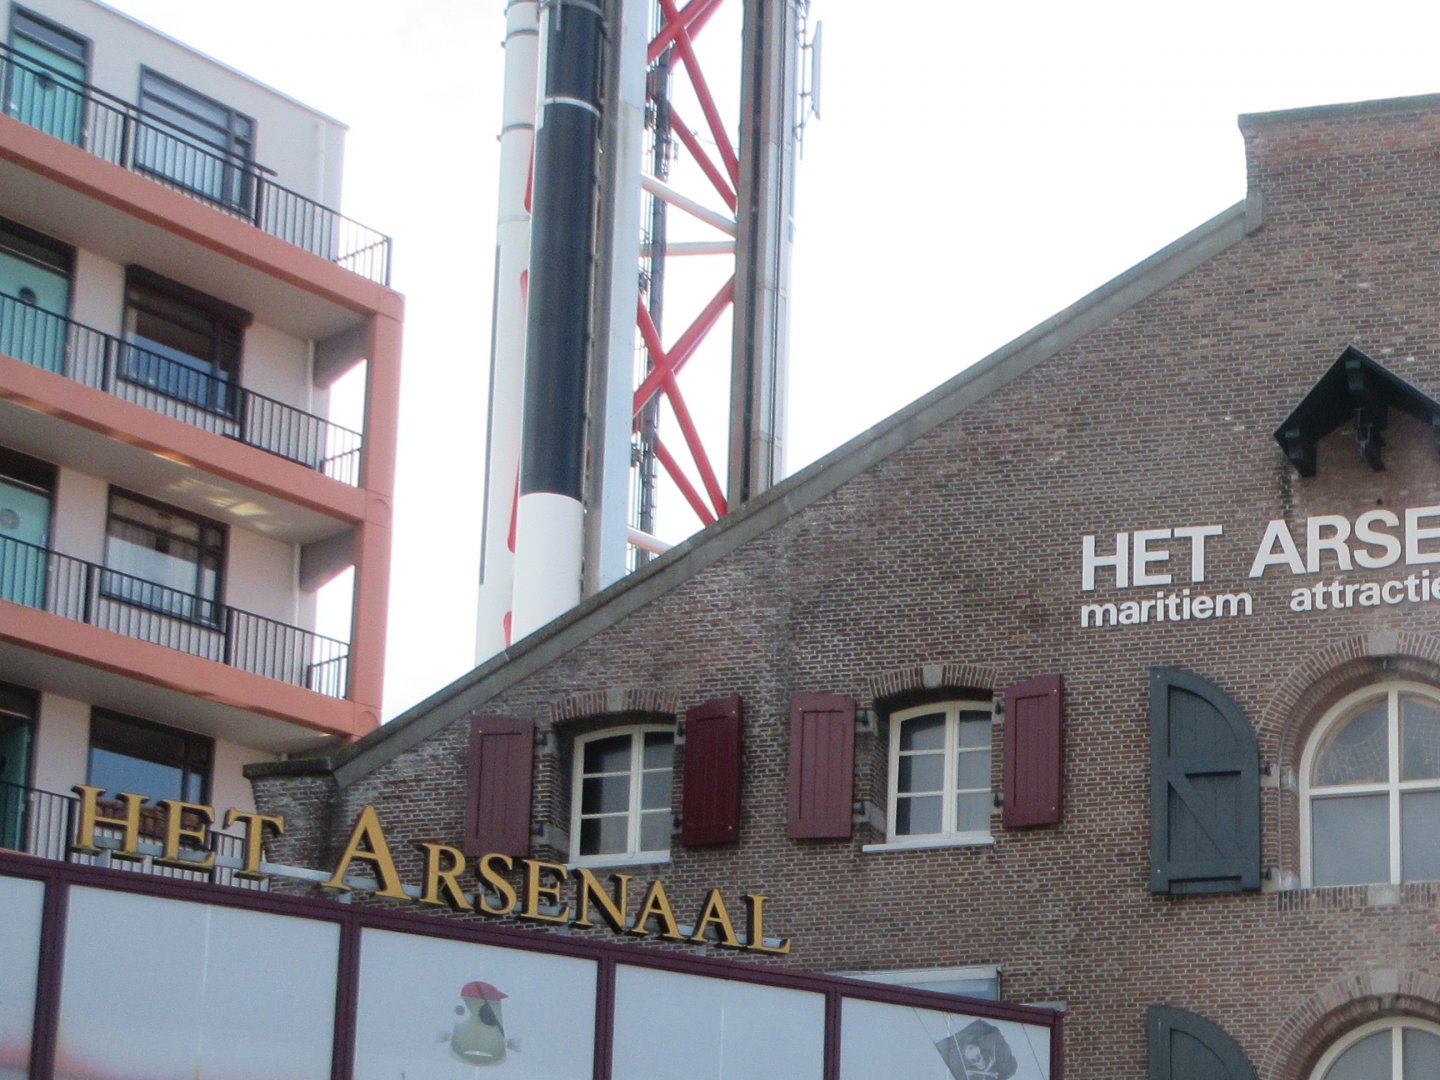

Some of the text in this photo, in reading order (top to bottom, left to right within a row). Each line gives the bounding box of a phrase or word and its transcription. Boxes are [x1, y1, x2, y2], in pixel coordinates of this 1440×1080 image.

[1081, 525, 1223, 591] HET
[1081, 587, 1253, 627] maritiem
[71, 784, 792, 955] HET ARSENAAL
